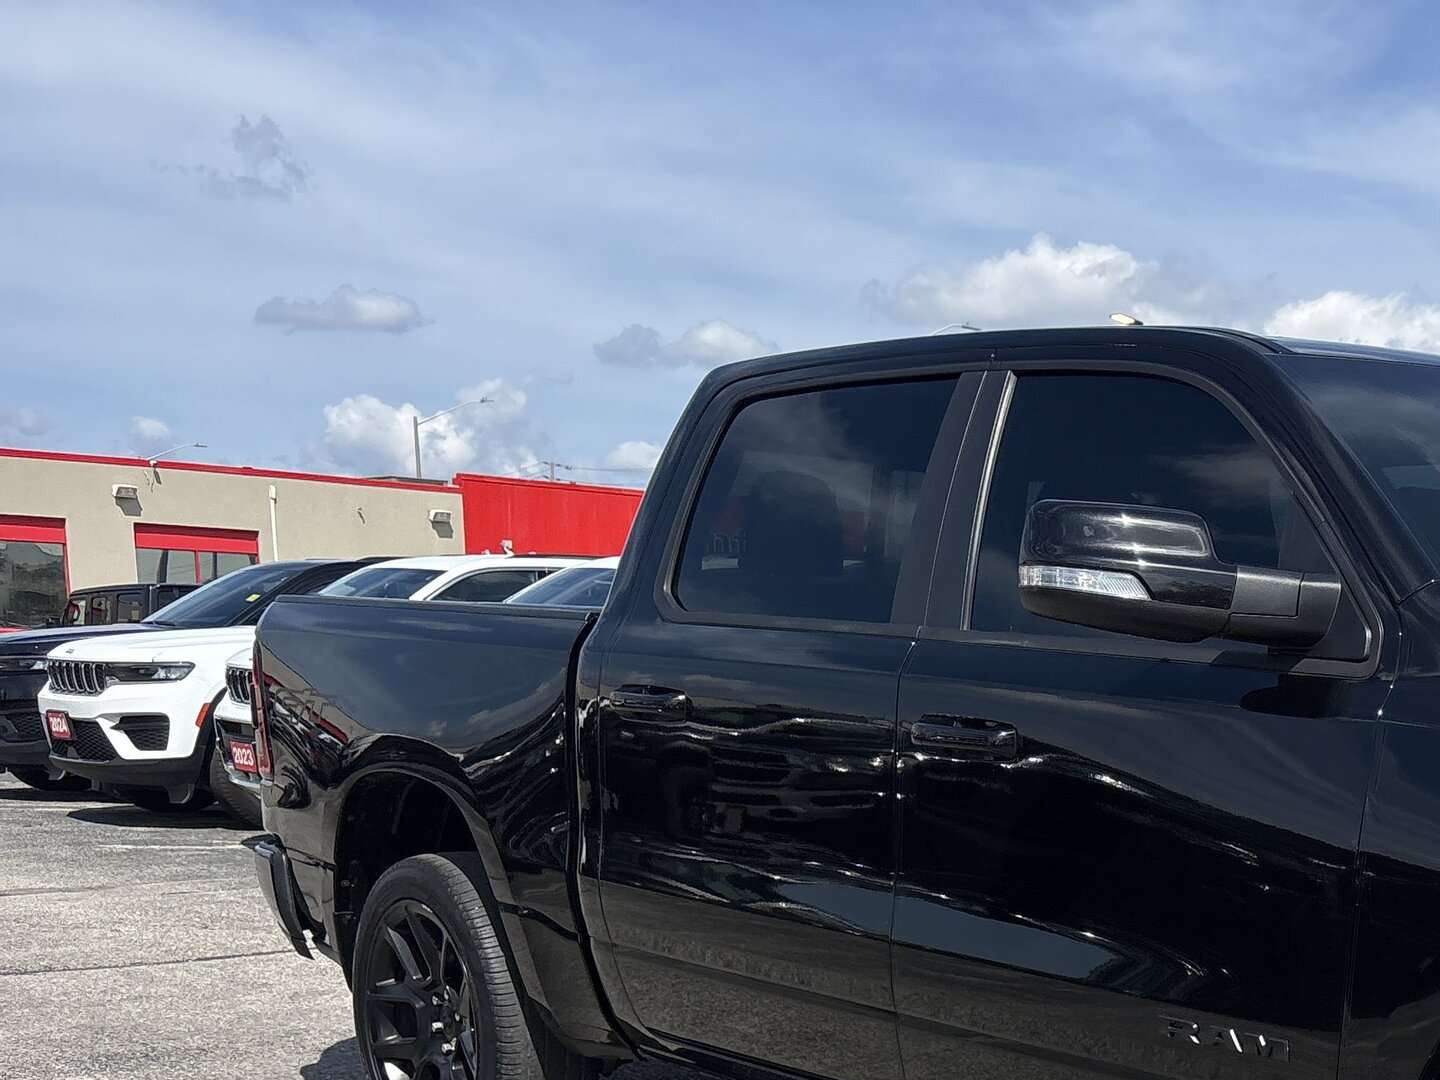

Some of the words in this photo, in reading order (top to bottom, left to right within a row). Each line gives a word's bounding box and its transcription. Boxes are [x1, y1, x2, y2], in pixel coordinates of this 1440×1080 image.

[49, 716, 68, 733] 2024
[232, 747, 253, 766] 2023
[1159, 1015, 1290, 1064] RAM
